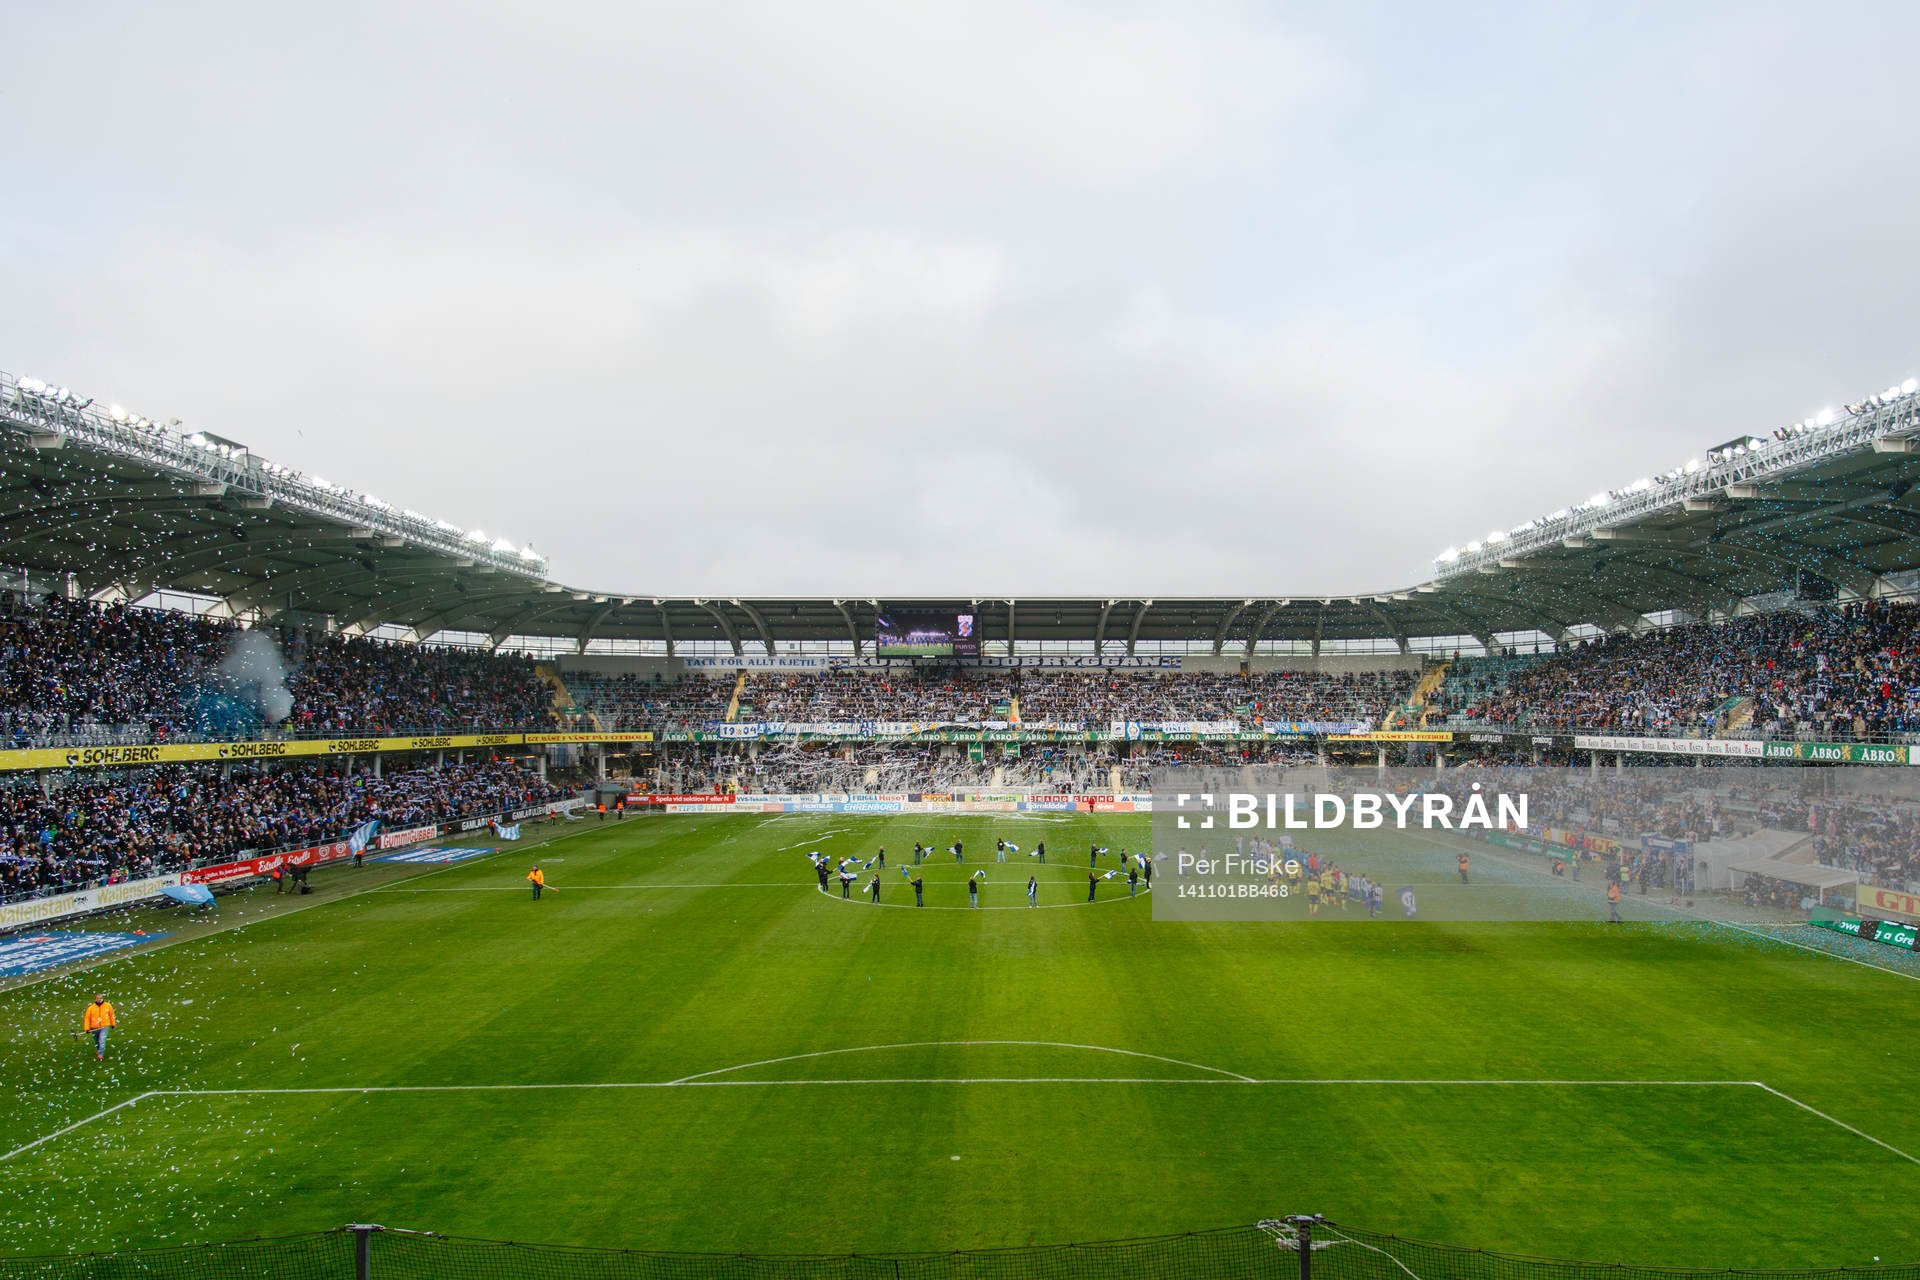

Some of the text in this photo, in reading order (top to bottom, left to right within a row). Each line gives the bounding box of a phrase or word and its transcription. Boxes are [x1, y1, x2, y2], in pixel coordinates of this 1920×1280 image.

[686, 657, 818, 668] TACK FÖR ALLT KJETIL
[722, 726, 736, 736] 19
[337, 740, 380, 751] SOHLBERG
[418, 738, 451, 747] SOHLBERG
[481, 736, 508, 744] SOHLBERG
[83, 747, 160, 764] SOHLBERG
[231, 743, 286, 757] SOHLBERG
[1766, 745, 1793, 757] ÅBRO
[1811, 746, 1841, 760] ÅBRO
[1861, 748, 1896, 762] ÅBRO
[97, 879, 164, 904] Wallenstam
